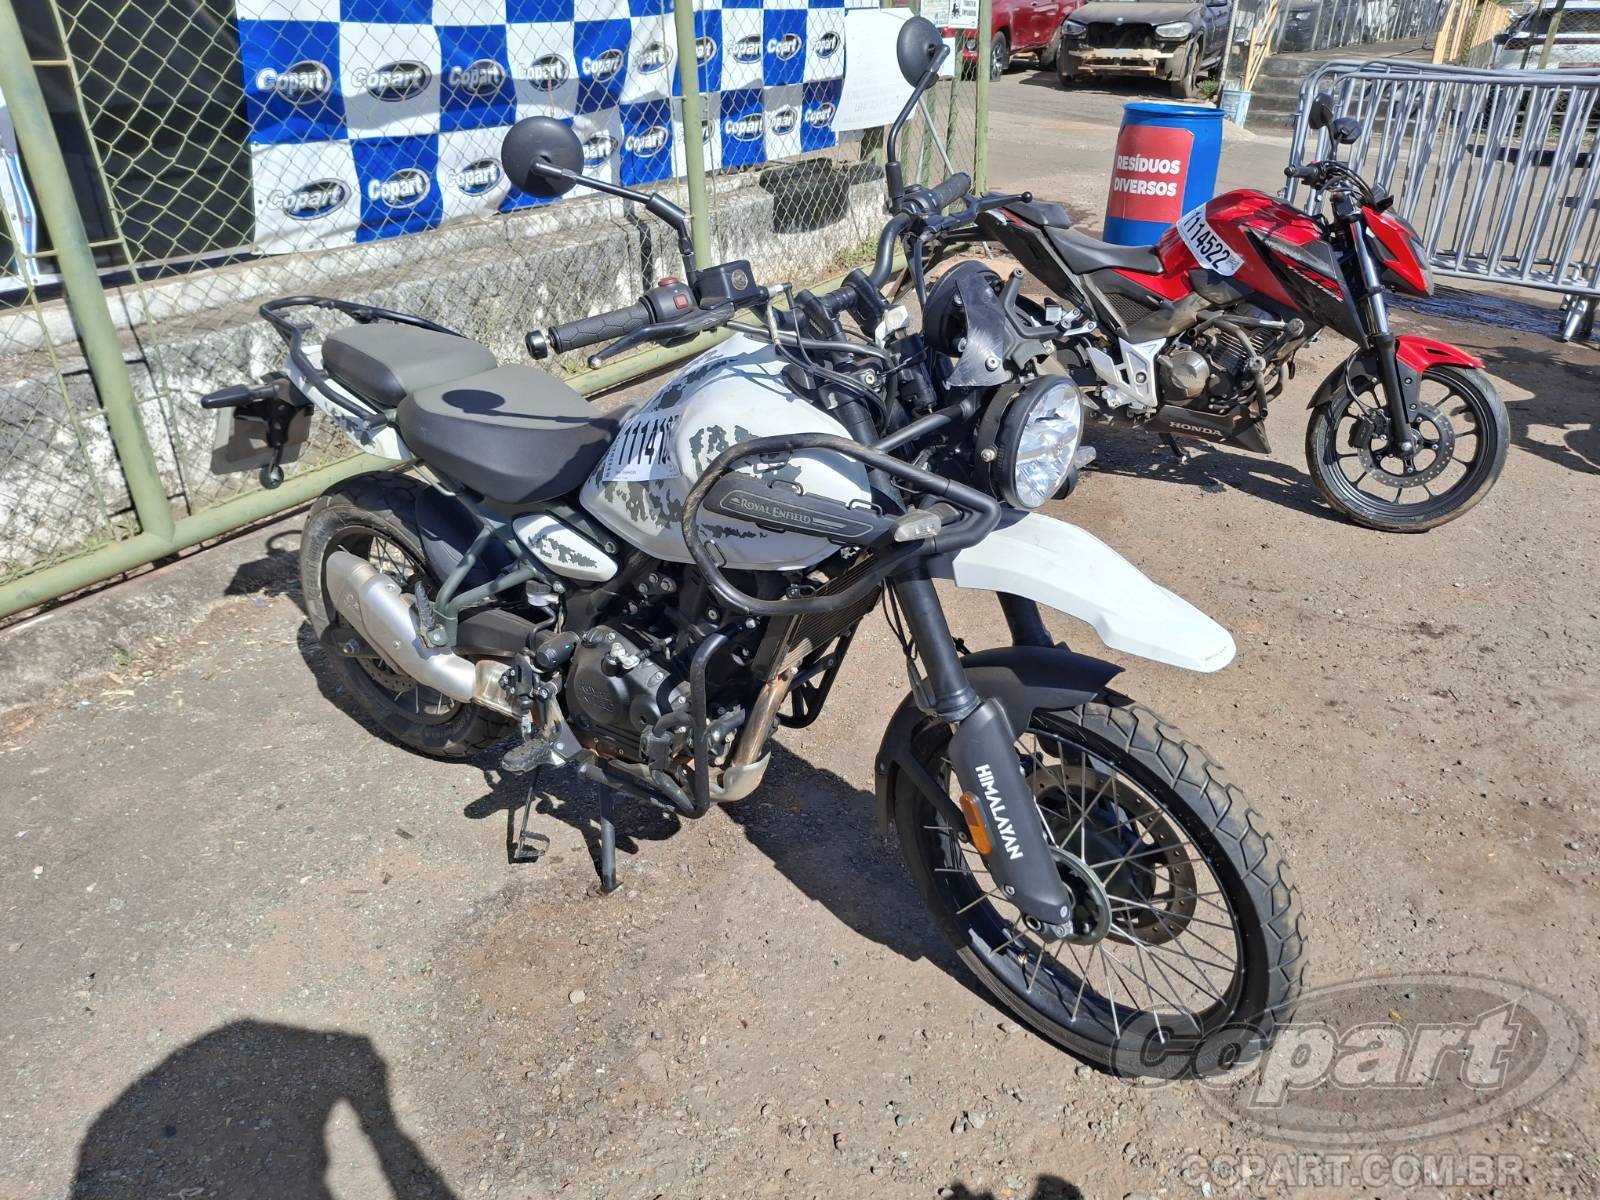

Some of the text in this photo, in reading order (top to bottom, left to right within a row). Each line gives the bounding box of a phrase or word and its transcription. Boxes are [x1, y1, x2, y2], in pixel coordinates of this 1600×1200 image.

[727, 38, 761, 58] Copar
[449, 64, 502, 91] Copart
[582, 55, 620, 78] Copart
[256, 67, 324, 98] Copart
[351, 67, 422, 95] Copart
[446, 163, 497, 190] Copart
[1116, 152, 1181, 175] RESÍDUOS
[368, 172, 423, 202] Copart
[1112, 180, 1177, 198] DIVERSOS
[1168, 421, 1224, 437] HONDA
[740, 497, 812, 525] ROYAL ENFIELD
[974, 763, 1024, 861] HIMALAYAN
